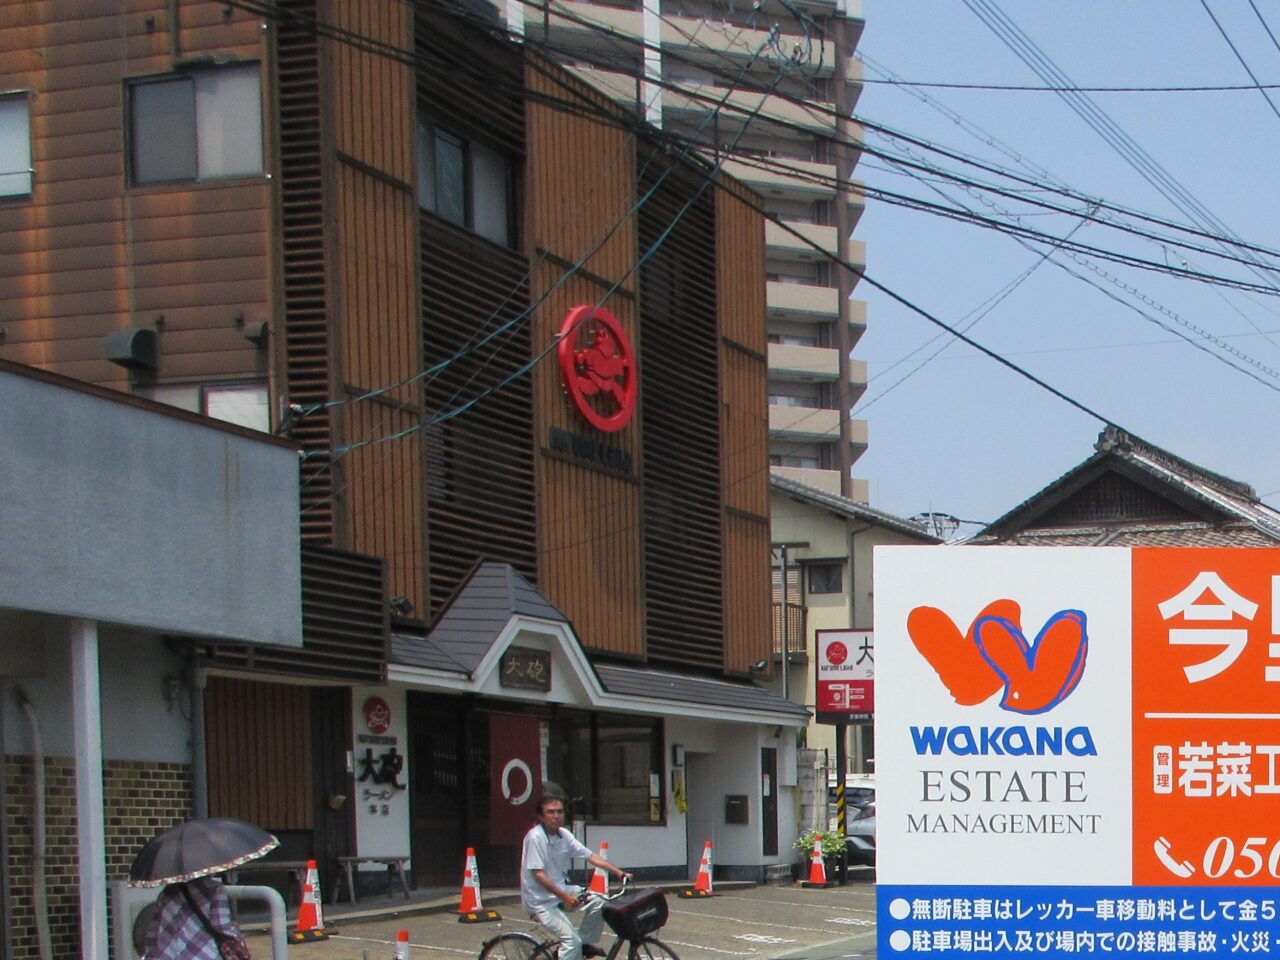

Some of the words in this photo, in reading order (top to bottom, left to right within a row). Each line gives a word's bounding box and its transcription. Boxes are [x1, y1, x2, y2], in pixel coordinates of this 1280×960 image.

[919, 769, 1088, 803] ESTATE
[1156, 752, 1170, 788] 管理
[906, 813, 1102, 834] MANAGEMENT
